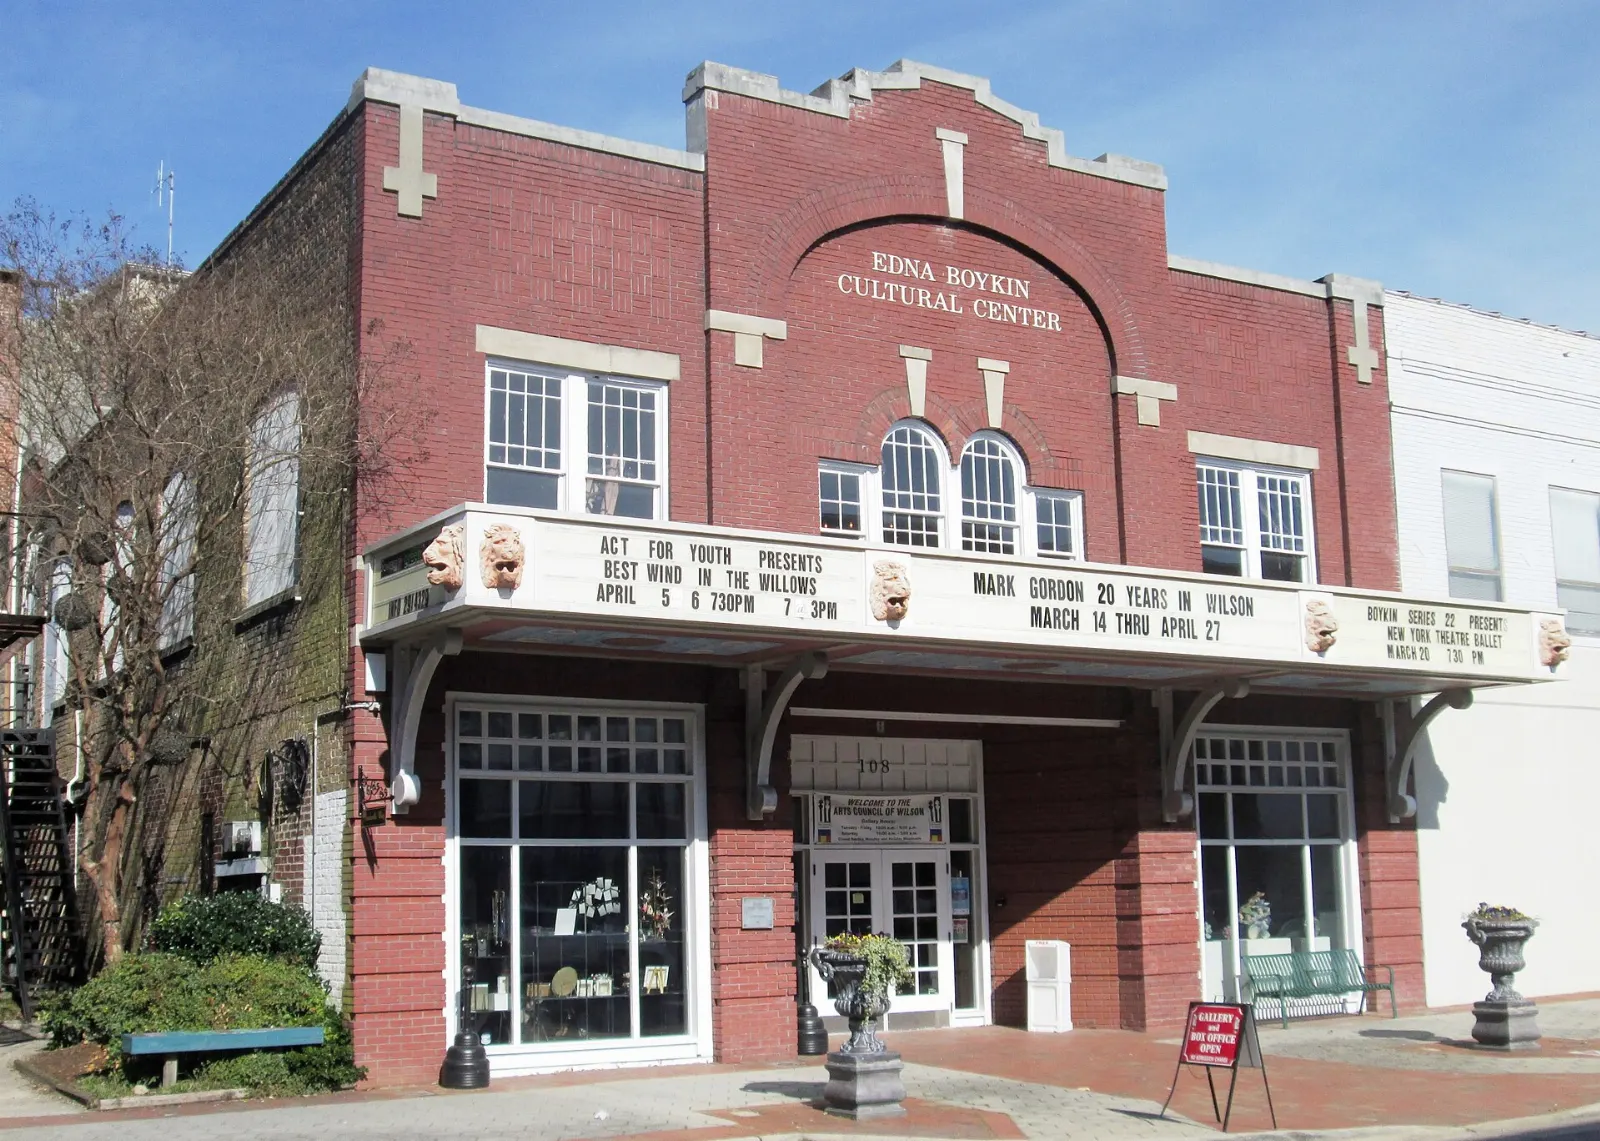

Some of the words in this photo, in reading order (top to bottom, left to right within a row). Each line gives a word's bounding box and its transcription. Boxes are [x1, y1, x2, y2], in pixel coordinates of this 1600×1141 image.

[871, 251, 936, 282] EDNA
[945, 265, 1030, 299] BOYKIN
[837, 273, 963, 314] CULTURAL
[973, 299, 1061, 331] CENTER
[600, 535, 629, 556] ACT
[649, 540, 673, 559] FOR
[690, 544, 731, 565] YOUTH
[759, 550, 822, 573] PRESENTS
[604, 560, 638, 580] BEST
[647, 563, 682, 584] WIND
[699, 568, 711, 586] IN
[727, 570, 749, 590] THE
[759, 573, 816, 595] WILLOWS
[597, 583, 636, 605] APRIL
[661, 589, 670, 607] 5
[691, 591, 699, 609] 6
[710, 592, 755, 613] 730PM
[784, 598, 791, 616] 7
[811, 600, 837, 620] 3PM
[973, 572, 1015, 597] MARK
[1029, 576, 1084, 602] GORDON
[1097, 582, 1115, 605] 20
[1126, 585, 1168, 609] YEARS
[1179, 590, 1191, 612] IN
[1206, 593, 1254, 617] WILSON
[1030, 606, 1079, 631] MARCH
[1093, 611, 1107, 633] 14
[1115, 612, 1150, 636] THRU
[1161, 616, 1198, 640] APRIL
[1205, 620, 1220, 641] 27
[1367, 606, 1398, 623] BOYKIN
[1408, 609, 1436, 626] SERIES
[1445, 613, 1455, 628] 22
[1469, 615, 1508, 632] PRESENTS
[1387, 626, 1405, 642] NEW
[1410, 628, 1431, 644] YORK
[1436, 630, 1470, 647] THEATRE
[1474, 632, 1502, 649] BALLET
[1387, 644, 1417, 661] MARCH
[1419, 646, 1430, 661] 20
[1447, 648, 1463, 663] 730
[1472, 650, 1485, 665] PM
[859, 759, 890, 773] 108
[833, 807, 851, 816] ARTS
[853, 807, 883, 816] COUNCIL
[885, 807, 894, 816] OF
[896, 807, 925, 816] WILSON
[848, 798, 885, 807] WELCOME
[887, 799, 896, 807] TO
[897, 799, 911, 807] THE
[1199, 1012, 1234, 1023] GALLERY
[1191, 1032, 1206, 1042] BOX
[1207, 1033, 1236, 1044] OFFICE
[1200, 1044, 1221, 1054] OPEN
